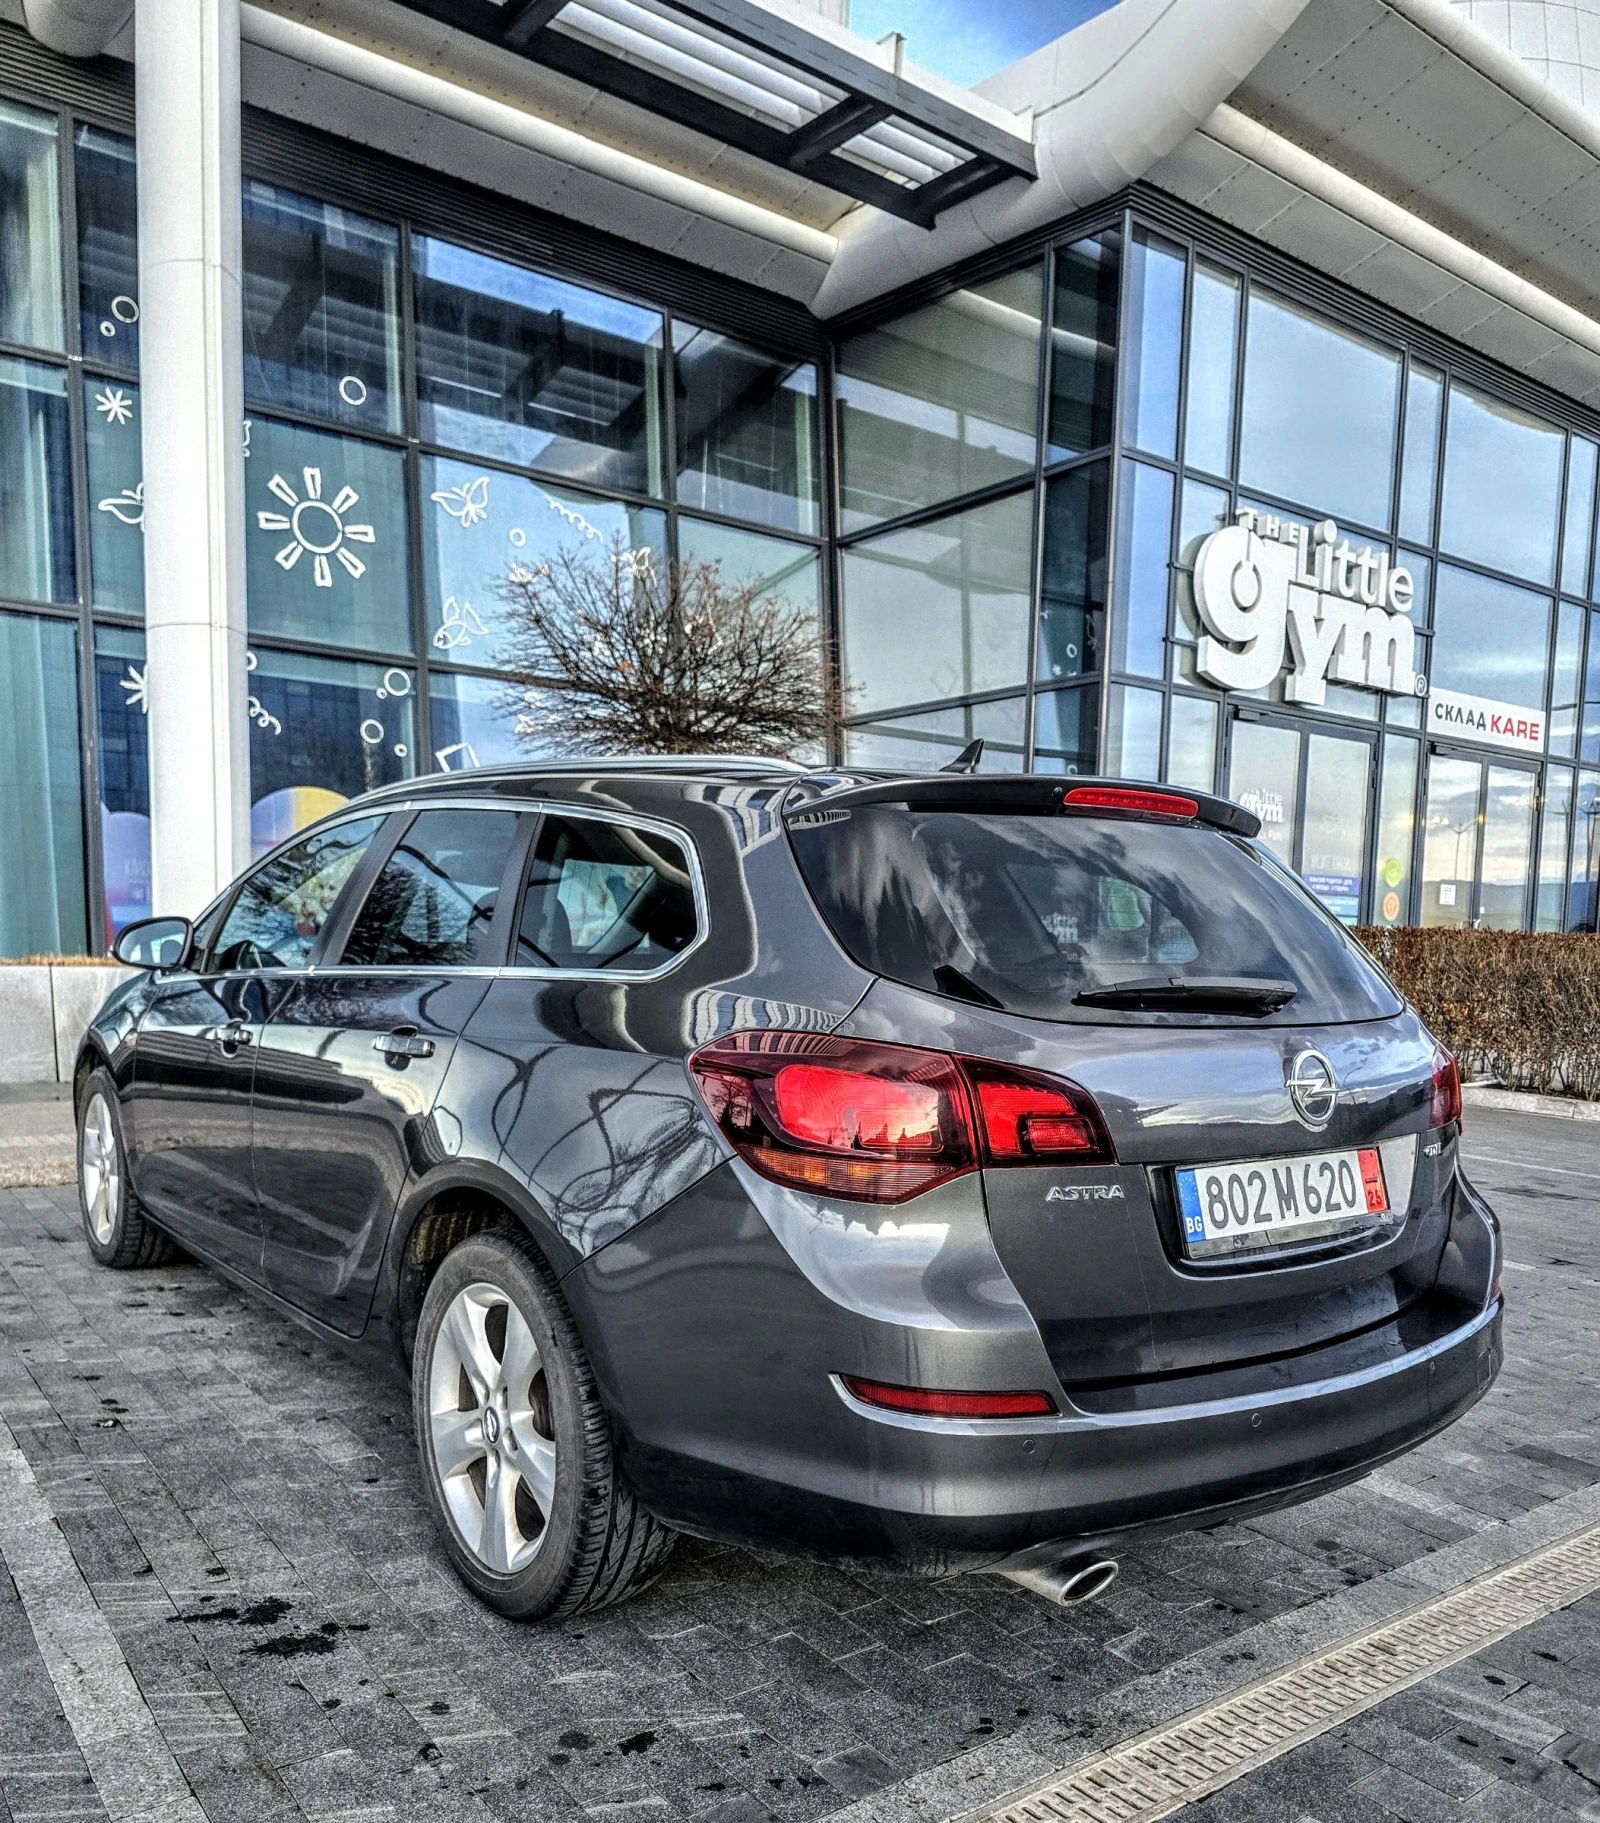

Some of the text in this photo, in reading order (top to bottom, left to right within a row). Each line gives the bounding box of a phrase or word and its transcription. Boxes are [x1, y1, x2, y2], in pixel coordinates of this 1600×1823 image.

[1235, 507, 1299, 543] THE
[1296, 519, 1414, 612] Little
[1194, 526, 1416, 705] gym
[1435, 702, 1540, 741] СКЛАД KARE
[1045, 1184, 1125, 1202] ASTRA
[1185, 1217, 1203, 1234] BG
